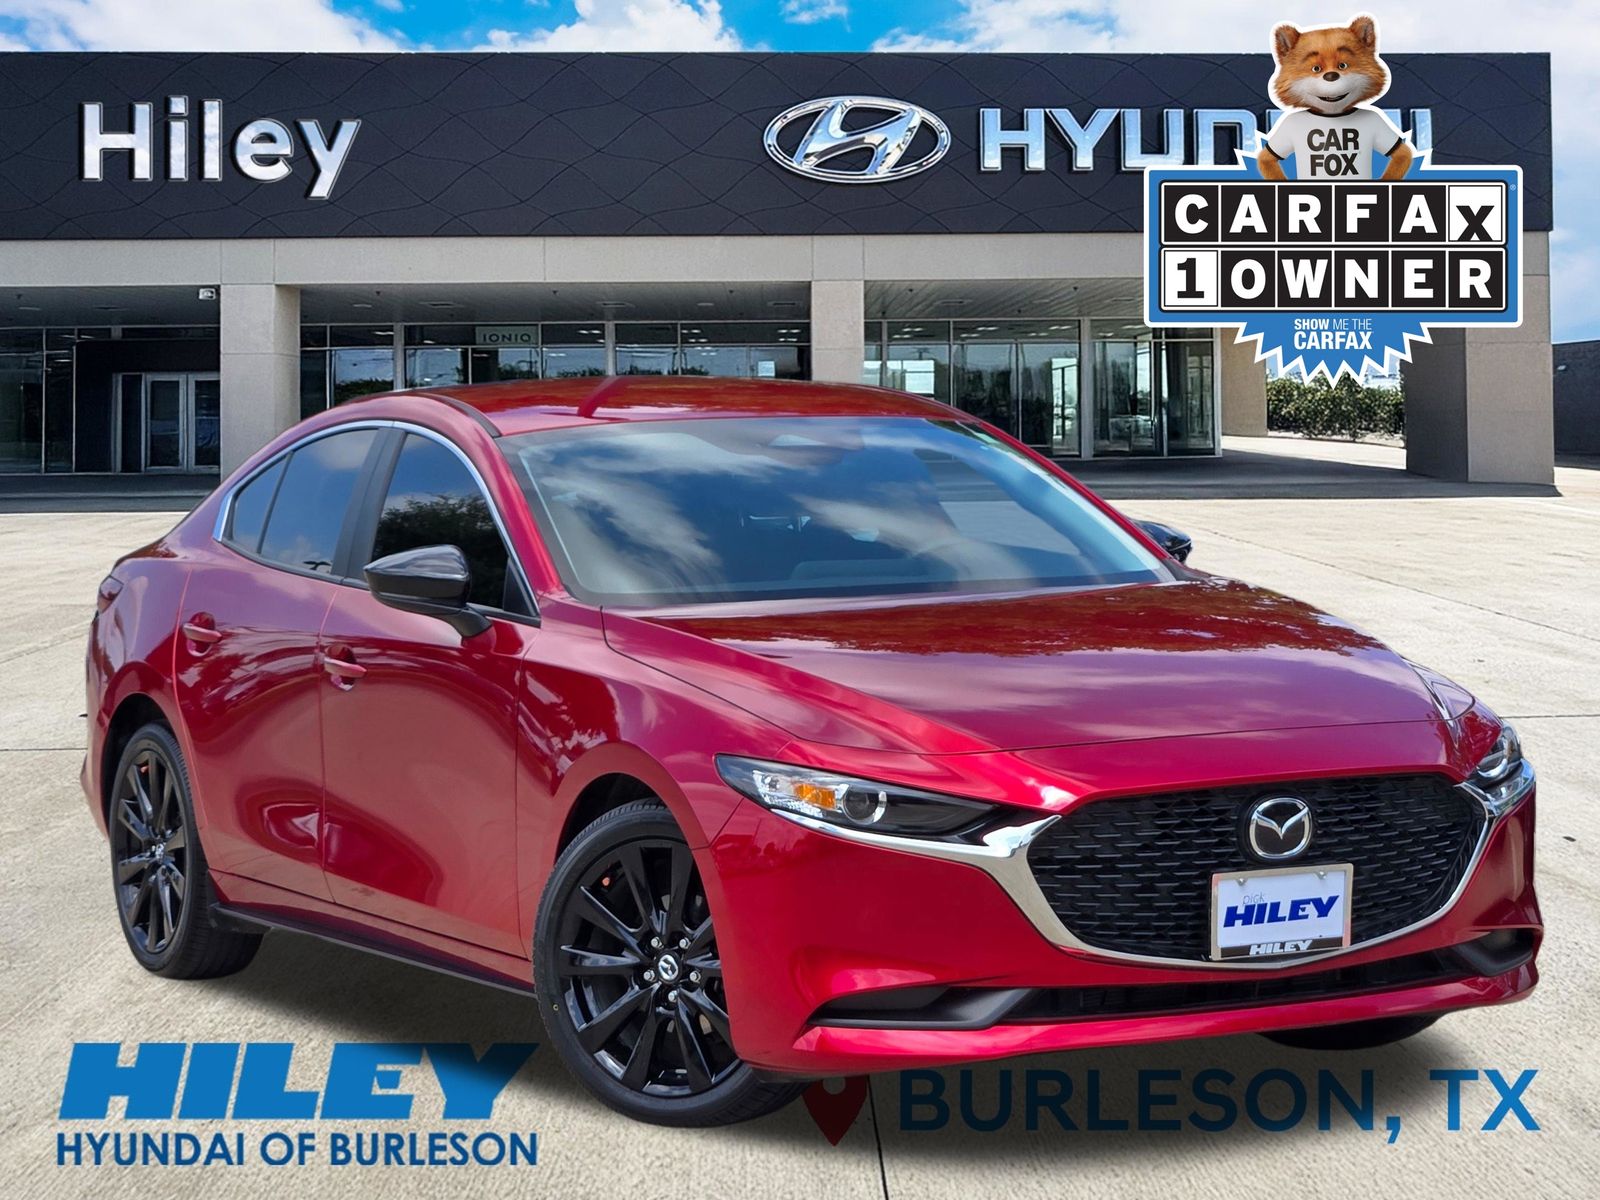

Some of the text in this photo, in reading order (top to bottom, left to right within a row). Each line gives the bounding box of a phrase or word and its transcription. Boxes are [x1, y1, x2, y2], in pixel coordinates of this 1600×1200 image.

[79, 95, 362, 200] Hiley
[978, 107, 1433, 172] HYUNI
[1223, 895, 1340, 928] HILEY
[1249, 939, 1314, 956] HILEY
